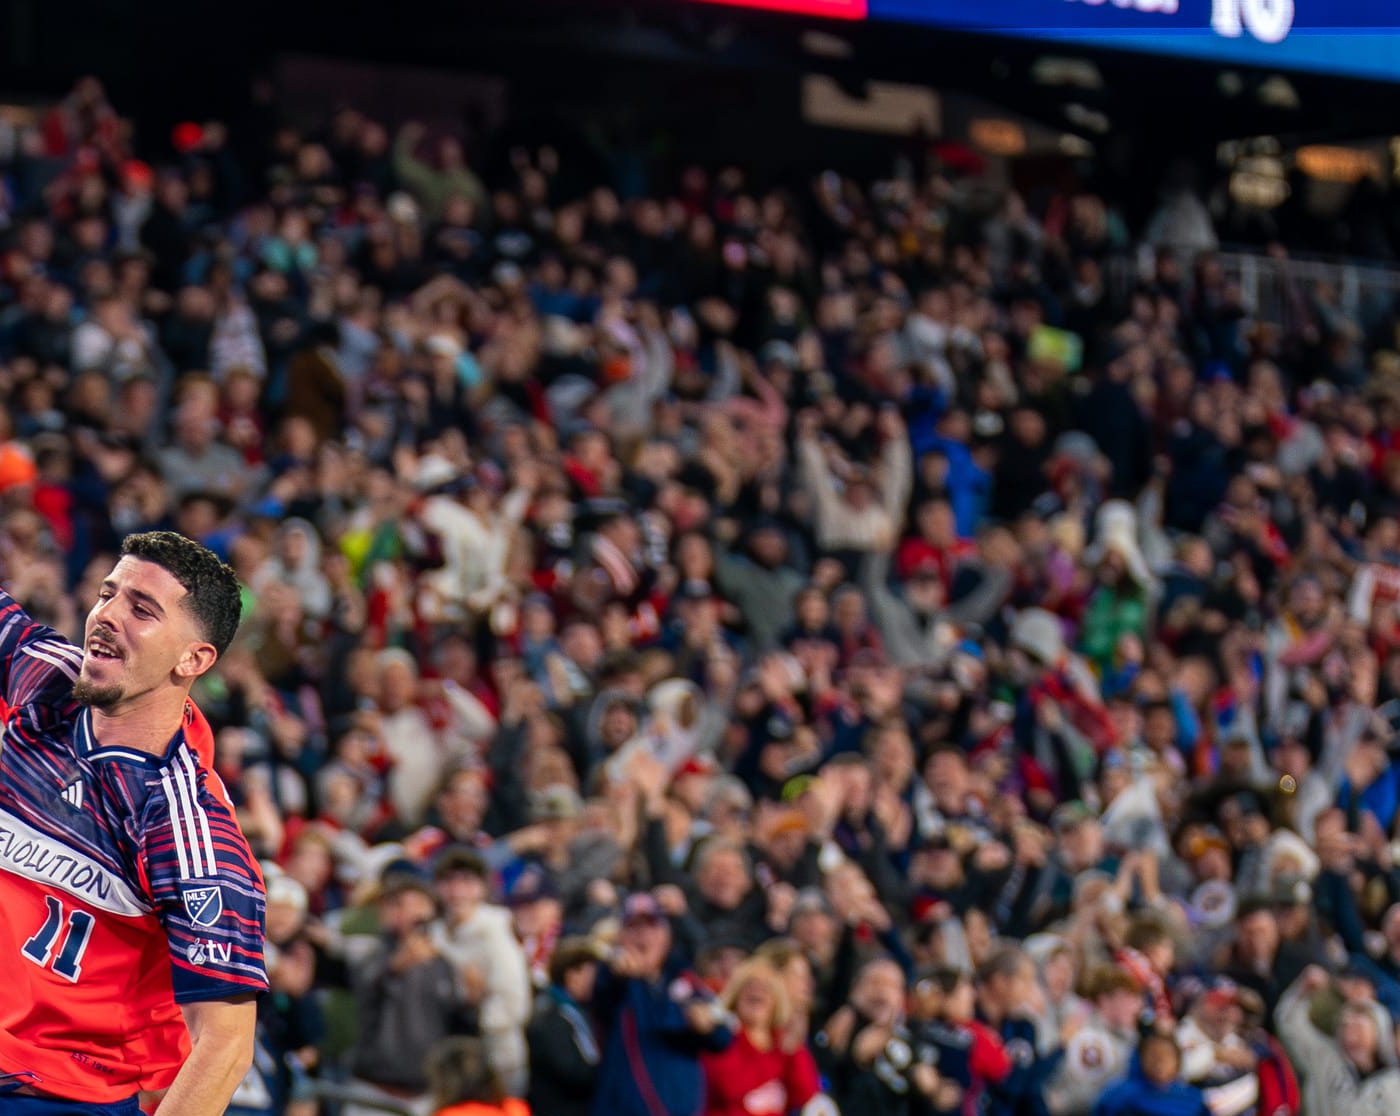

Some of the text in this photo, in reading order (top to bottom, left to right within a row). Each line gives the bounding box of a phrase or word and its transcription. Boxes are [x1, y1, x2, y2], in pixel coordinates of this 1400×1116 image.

[187, 891, 207, 902] MLS
[21, 895, 96, 984] 11
[206, 940, 232, 963] tv
